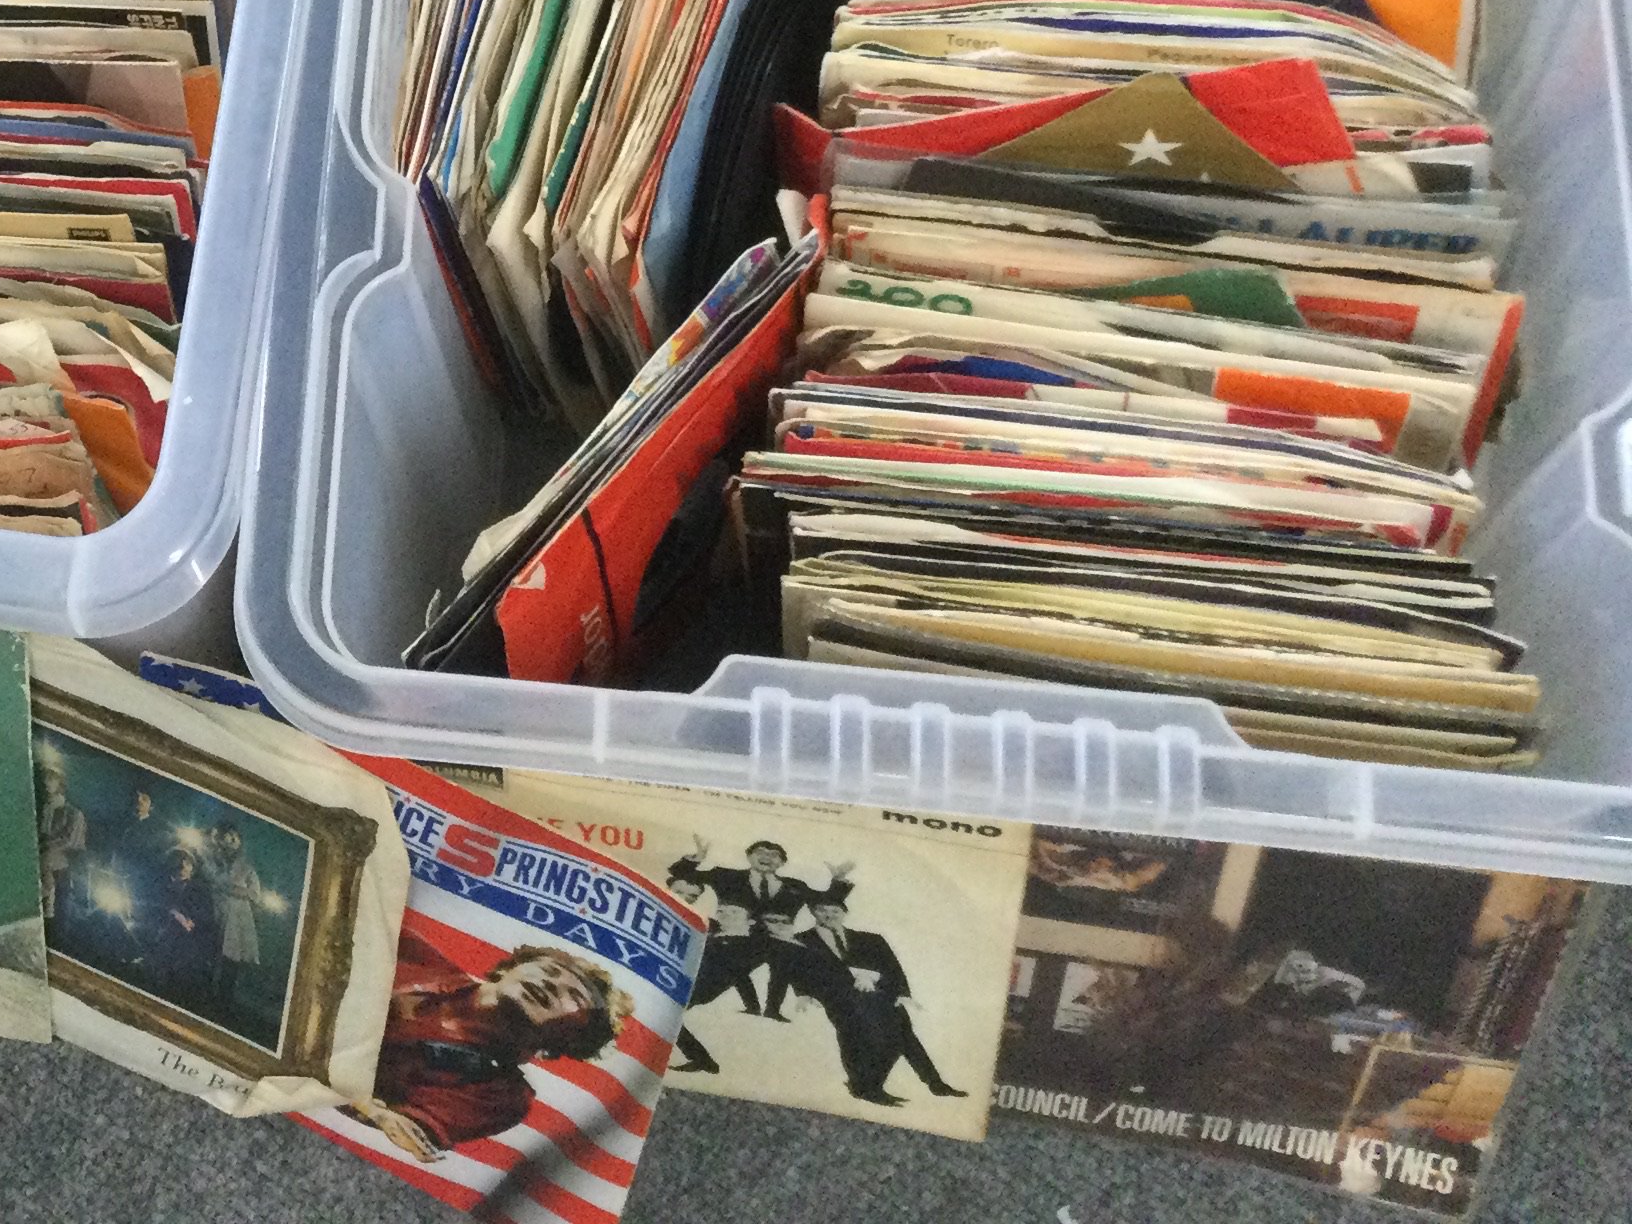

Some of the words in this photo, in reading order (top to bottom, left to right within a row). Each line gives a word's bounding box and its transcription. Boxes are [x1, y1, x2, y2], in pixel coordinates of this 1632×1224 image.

[576, 821, 645, 851] YOU
[881, 809, 1004, 839] mono
[436, 823, 692, 962] SPRINGSTEEN
[526, 900, 678, 991] DAYS
[157, 1046, 199, 1076] The
[1201, 1115, 1233, 1143] TO
[1236, 1120, 1339, 1166] MILTON
[1349, 1134, 1460, 1196] KEYNES
